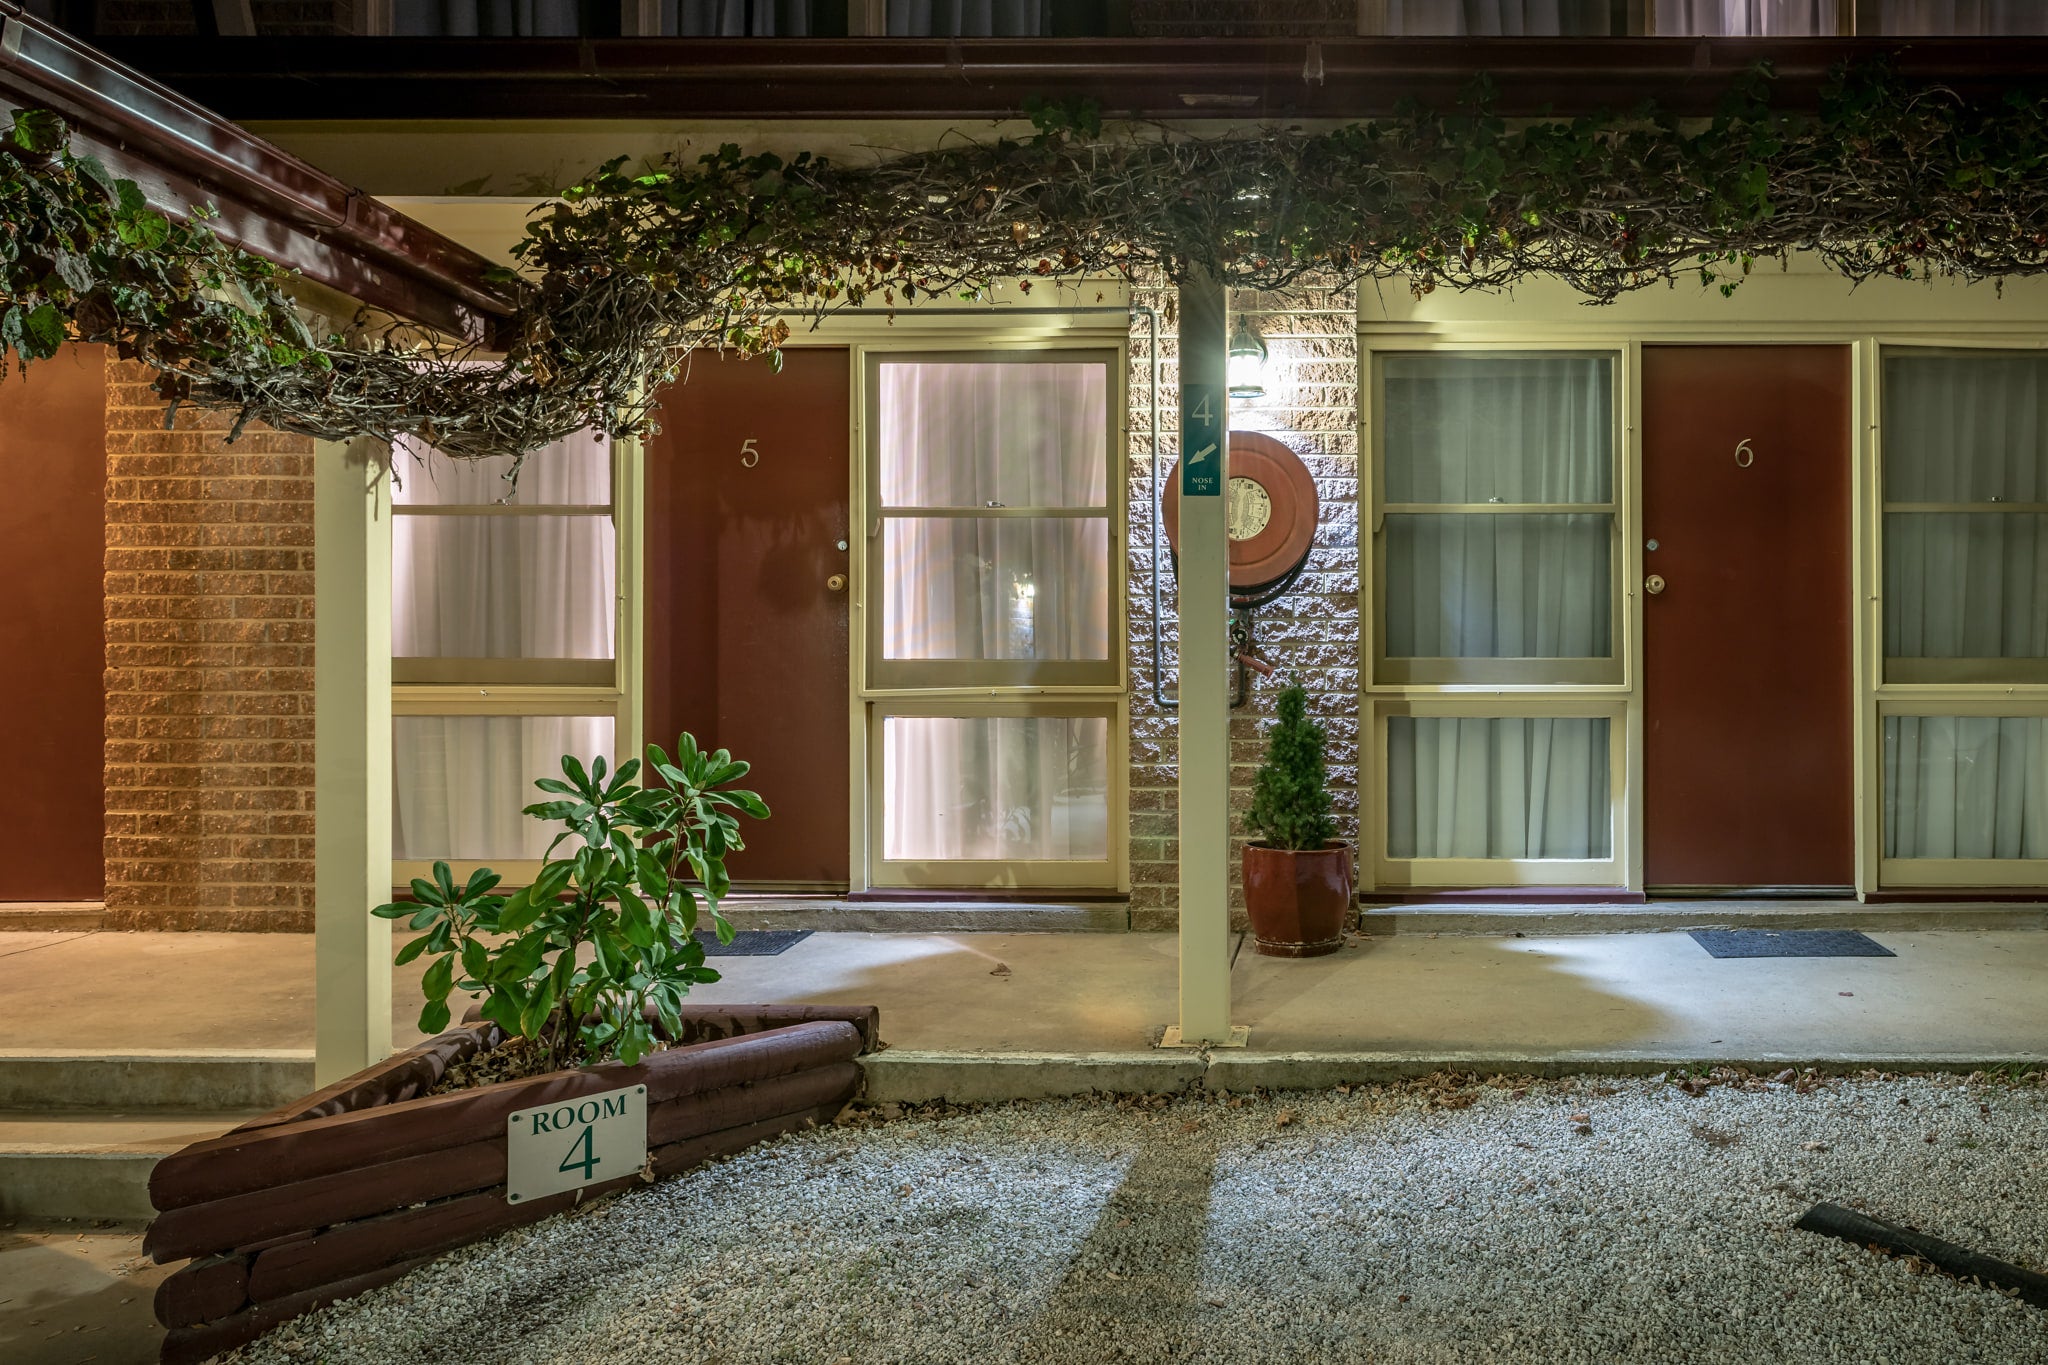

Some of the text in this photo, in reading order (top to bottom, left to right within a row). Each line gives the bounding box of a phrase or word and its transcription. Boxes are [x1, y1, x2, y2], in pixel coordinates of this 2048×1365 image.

[1191, 393, 1214, 427] 4
[740, 439, 759, 468] 5
[1734, 438, 1754, 468] 6
[530, 1094, 627, 1136] ROOM
[559, 1124, 601, 1181] 4
